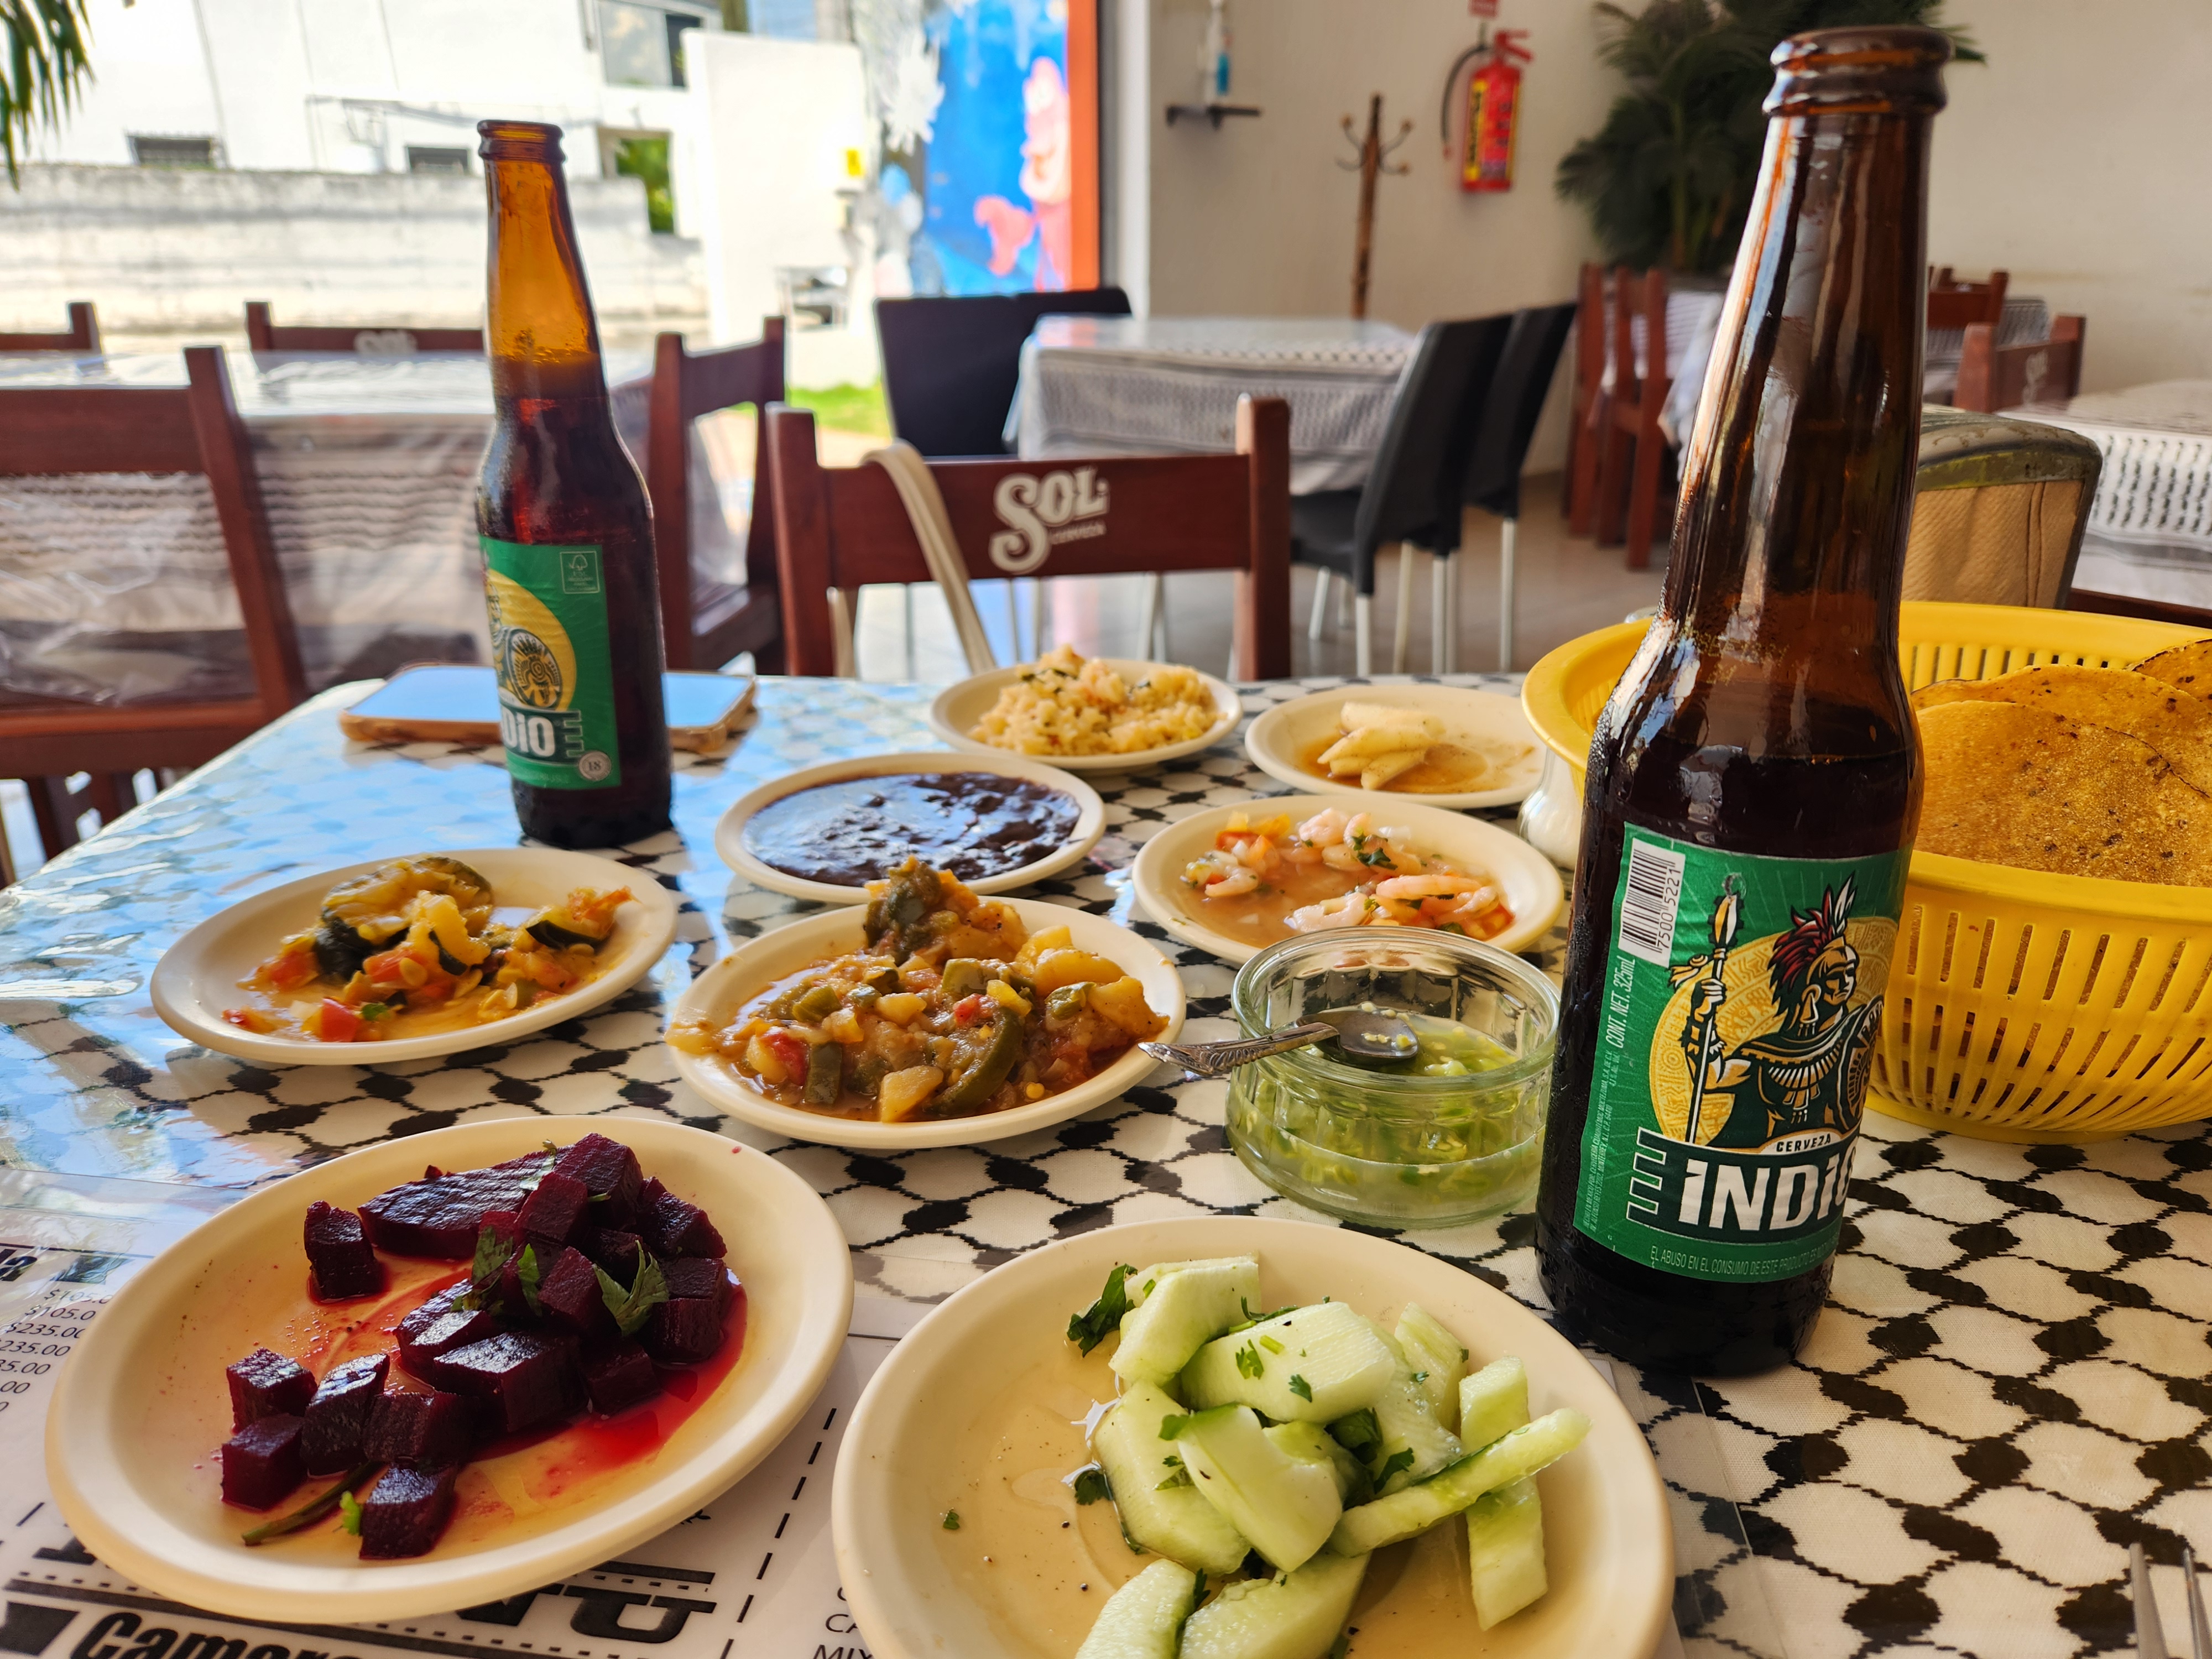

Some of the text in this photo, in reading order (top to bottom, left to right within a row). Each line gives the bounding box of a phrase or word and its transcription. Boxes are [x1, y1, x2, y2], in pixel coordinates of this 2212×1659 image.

[988, 465, 1110, 575] SOL
[502, 707, 555, 757] DIO
[1657, 868, 1681, 948] 7500 5221
[1605, 956, 1635, 1048] CONT. NET. 325mL
[1776, 1133, 1832, 1152] CERVEZA
[1650, 1245, 1659, 1261] EL
[1661, 1249, 1687, 1268] ABUSO
[1688, 1255, 1698, 1270] EN
[1700, 1257, 1709, 1272] EL
[1712, 1259, 1750, 1275] CONSUMO
[1750, 1261, 1761, 1275] DE
[1761, 1259, 1778, 1274] ESTE
[44, 1288, 113, 1305] $105.0
[24, 1305, 96, 1321] $105.0
[0, 1340, 71, 1357] 235.00
